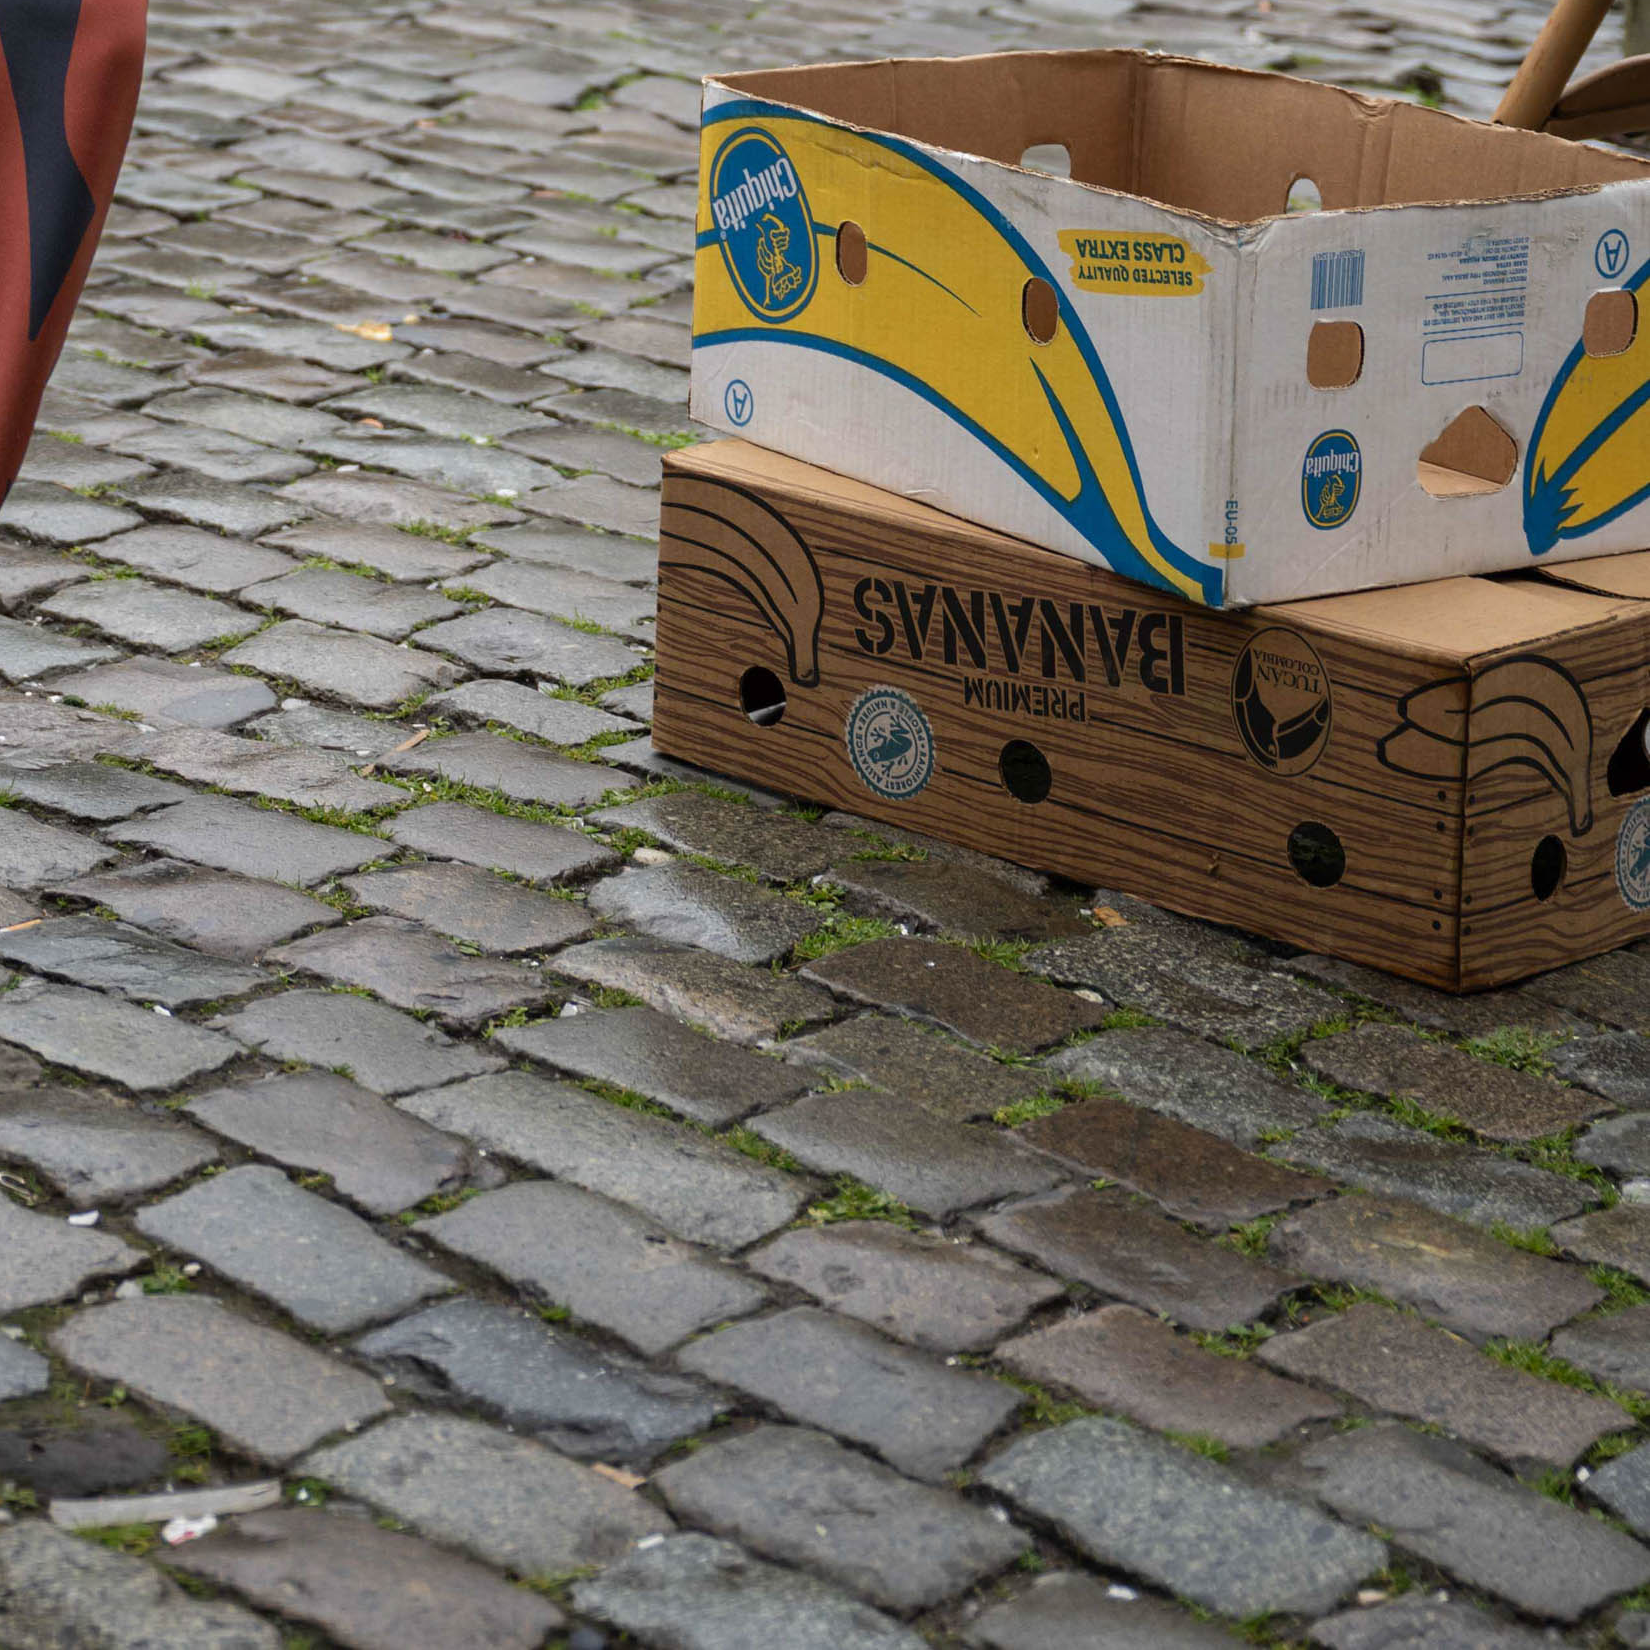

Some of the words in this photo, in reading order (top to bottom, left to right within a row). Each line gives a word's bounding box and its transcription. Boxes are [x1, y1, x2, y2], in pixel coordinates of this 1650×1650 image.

[1075, 238, 1130, 261] EXTRA
[1133, 241, 1186, 263] CLASS
[1078, 265, 1130, 282] QUALITY
[1133, 268, 1193, 286] SELECTED
[1225, 500, 1238, 545] EU-05
[854, 576, 1186, 696] BANANAS
[1253, 649, 1320, 676] COLOMBIA
[1255, 664, 1322, 695] TUCÁN
[858, 699, 887, 724] NATURE
[962, 677, 1087, 722] PREMIUM
[855, 732, 883, 784] ALLIANCE
[884, 751, 927, 791] RAINFOREST
